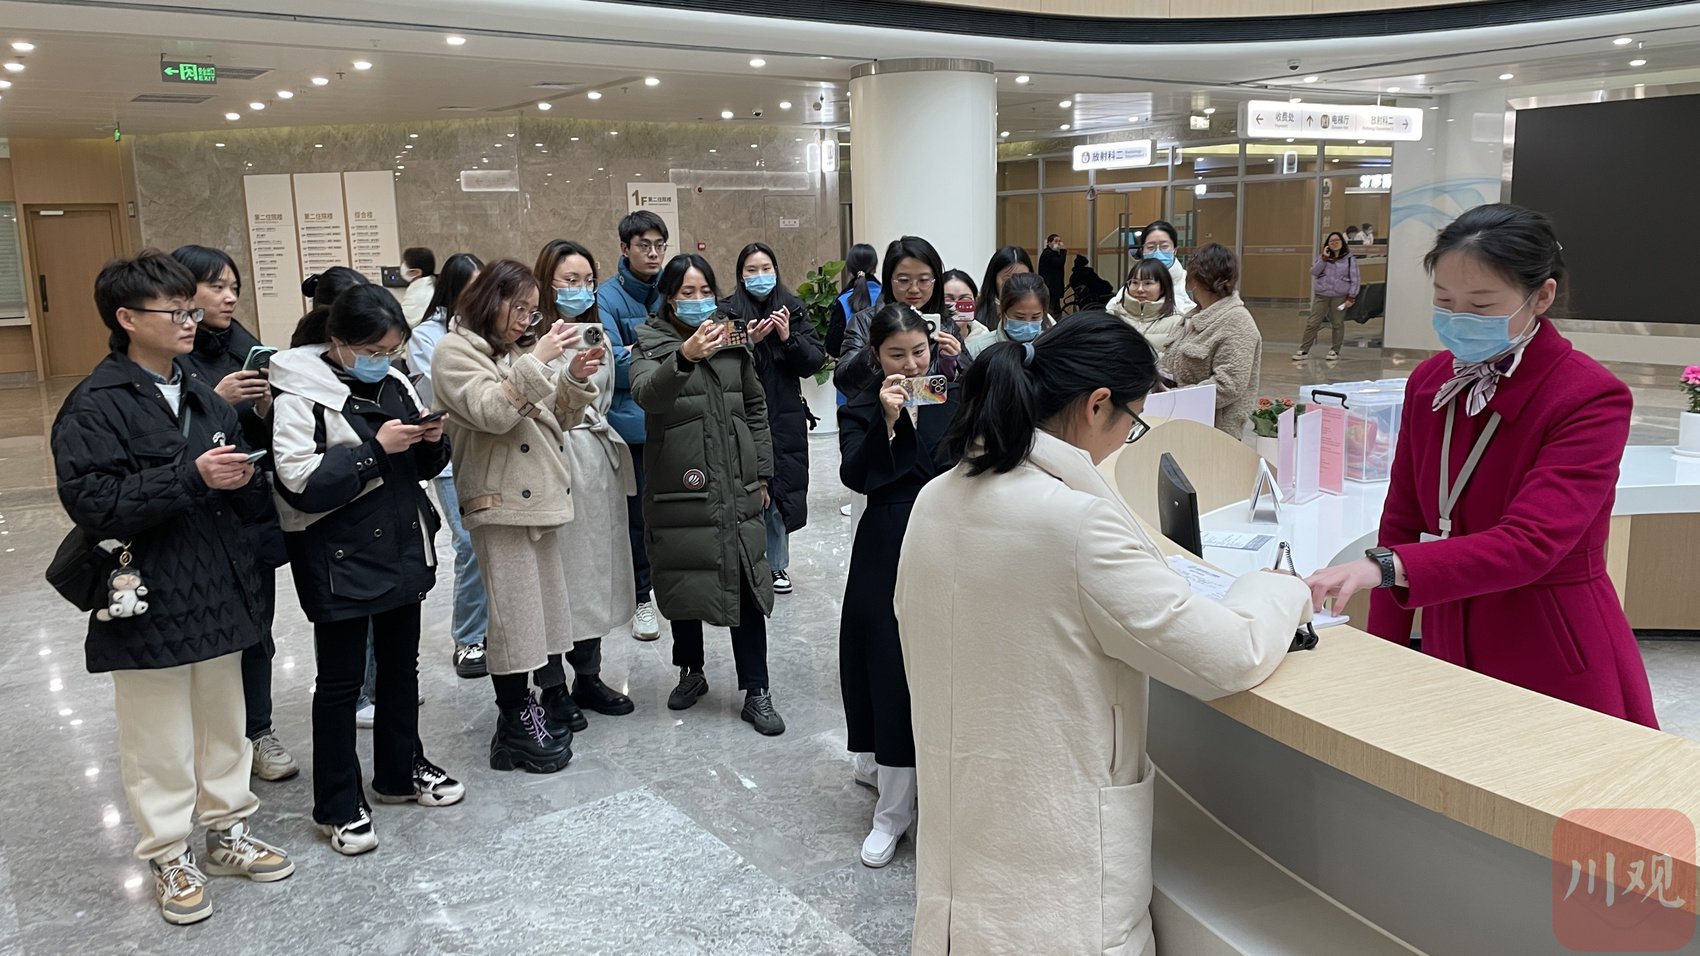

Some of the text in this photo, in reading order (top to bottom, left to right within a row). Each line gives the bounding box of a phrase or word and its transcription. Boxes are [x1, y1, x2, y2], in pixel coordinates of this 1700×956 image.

[1275, 112, 1295, 122] 收费处
[1331, 115, 1350, 125] 电梯厅
[1092, 150, 1124, 161] 放射科二
[631, 190, 647, 206] 1F
